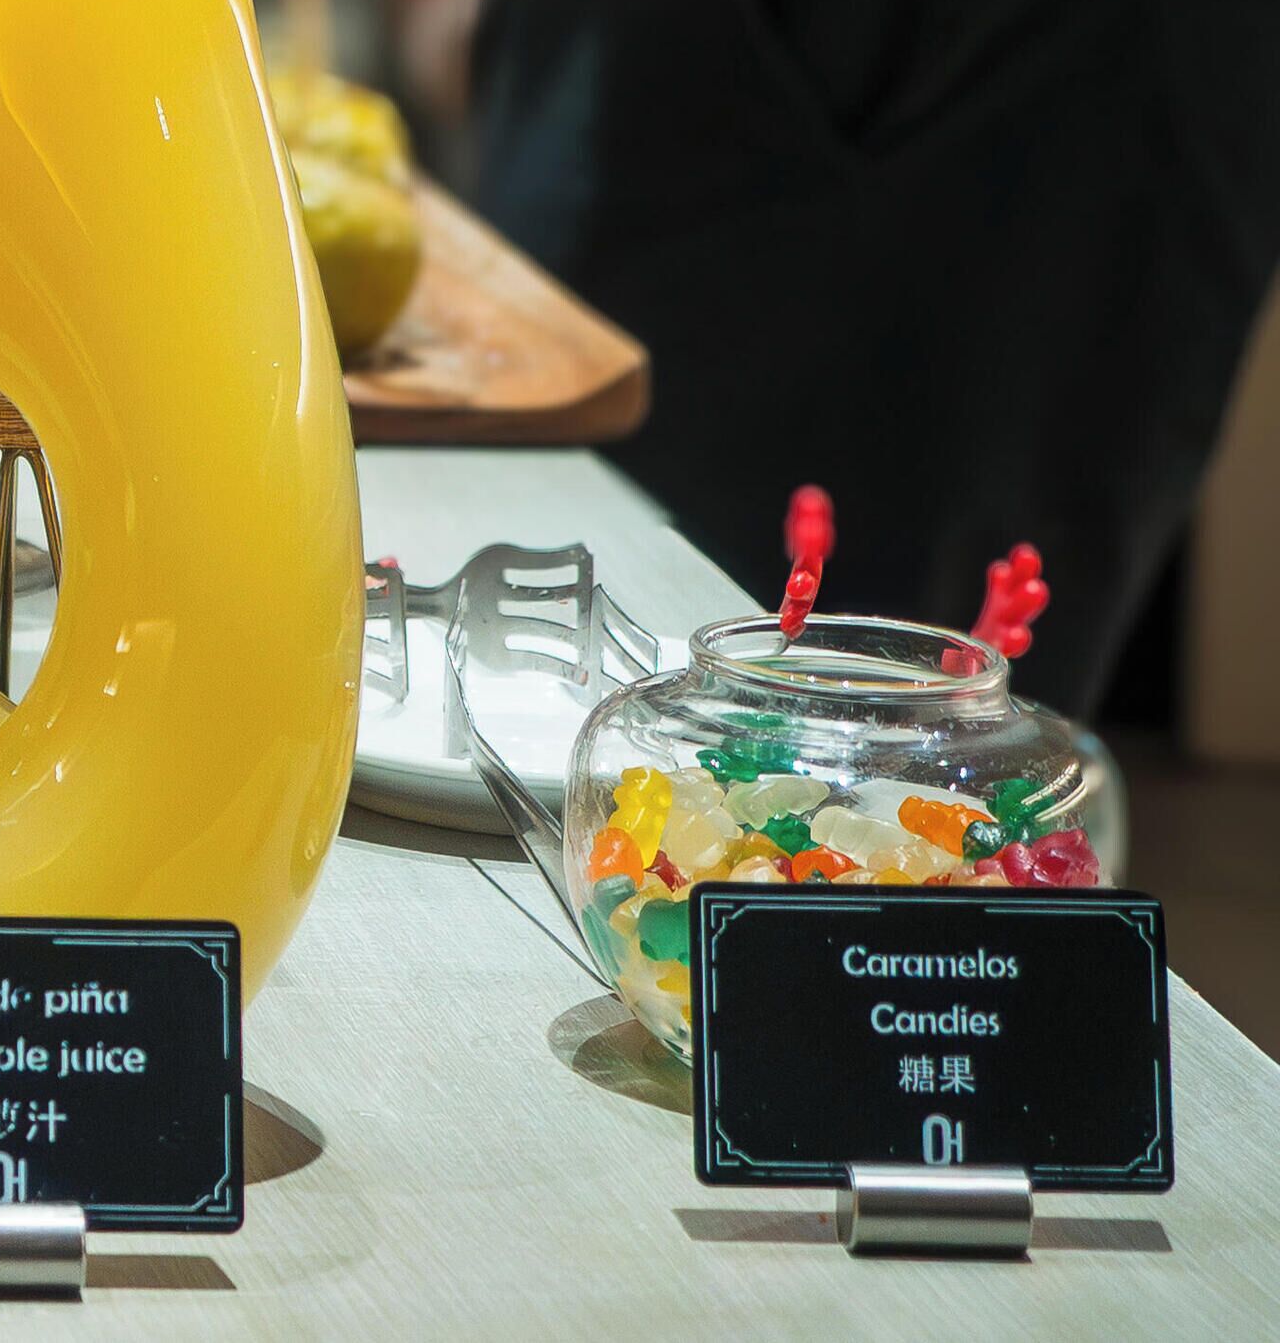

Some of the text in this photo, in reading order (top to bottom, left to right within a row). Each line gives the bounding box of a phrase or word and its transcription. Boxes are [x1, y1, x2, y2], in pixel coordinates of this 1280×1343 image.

[842, 945, 1018, 979] Caramelos
[44, 982, 129, 1019] piña
[870, 1003, 1000, 1036] Candies
[57, 1040, 147, 1078] juice
[898, 1055, 975, 1094] 糖果
